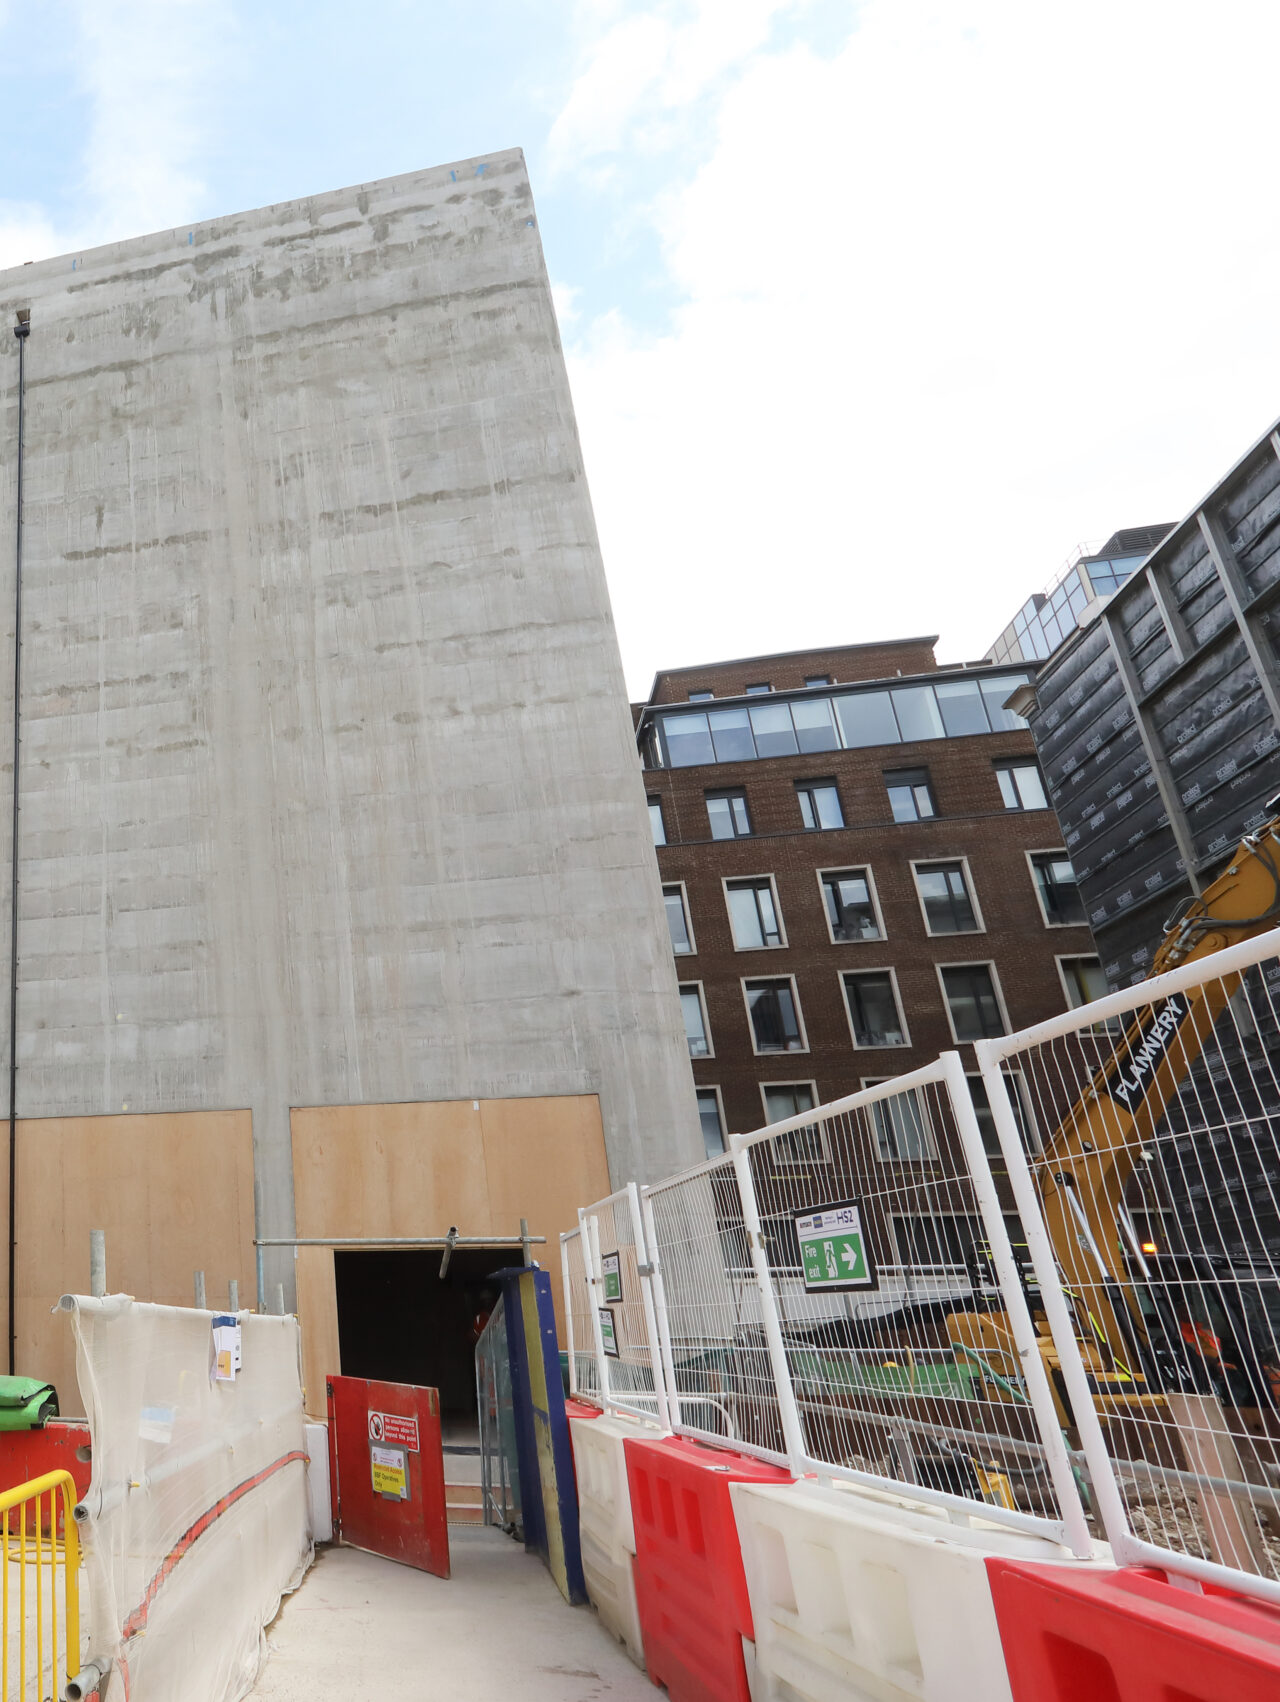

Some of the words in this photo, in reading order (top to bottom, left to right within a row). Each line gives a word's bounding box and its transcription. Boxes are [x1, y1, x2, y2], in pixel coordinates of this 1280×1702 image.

[1114, 997, 1183, 1103] FLANNERY
[836, 1210, 854, 1225] HS2
[804, 1244, 817, 1258] Fire
[808, 1264, 821, 1278] exit
